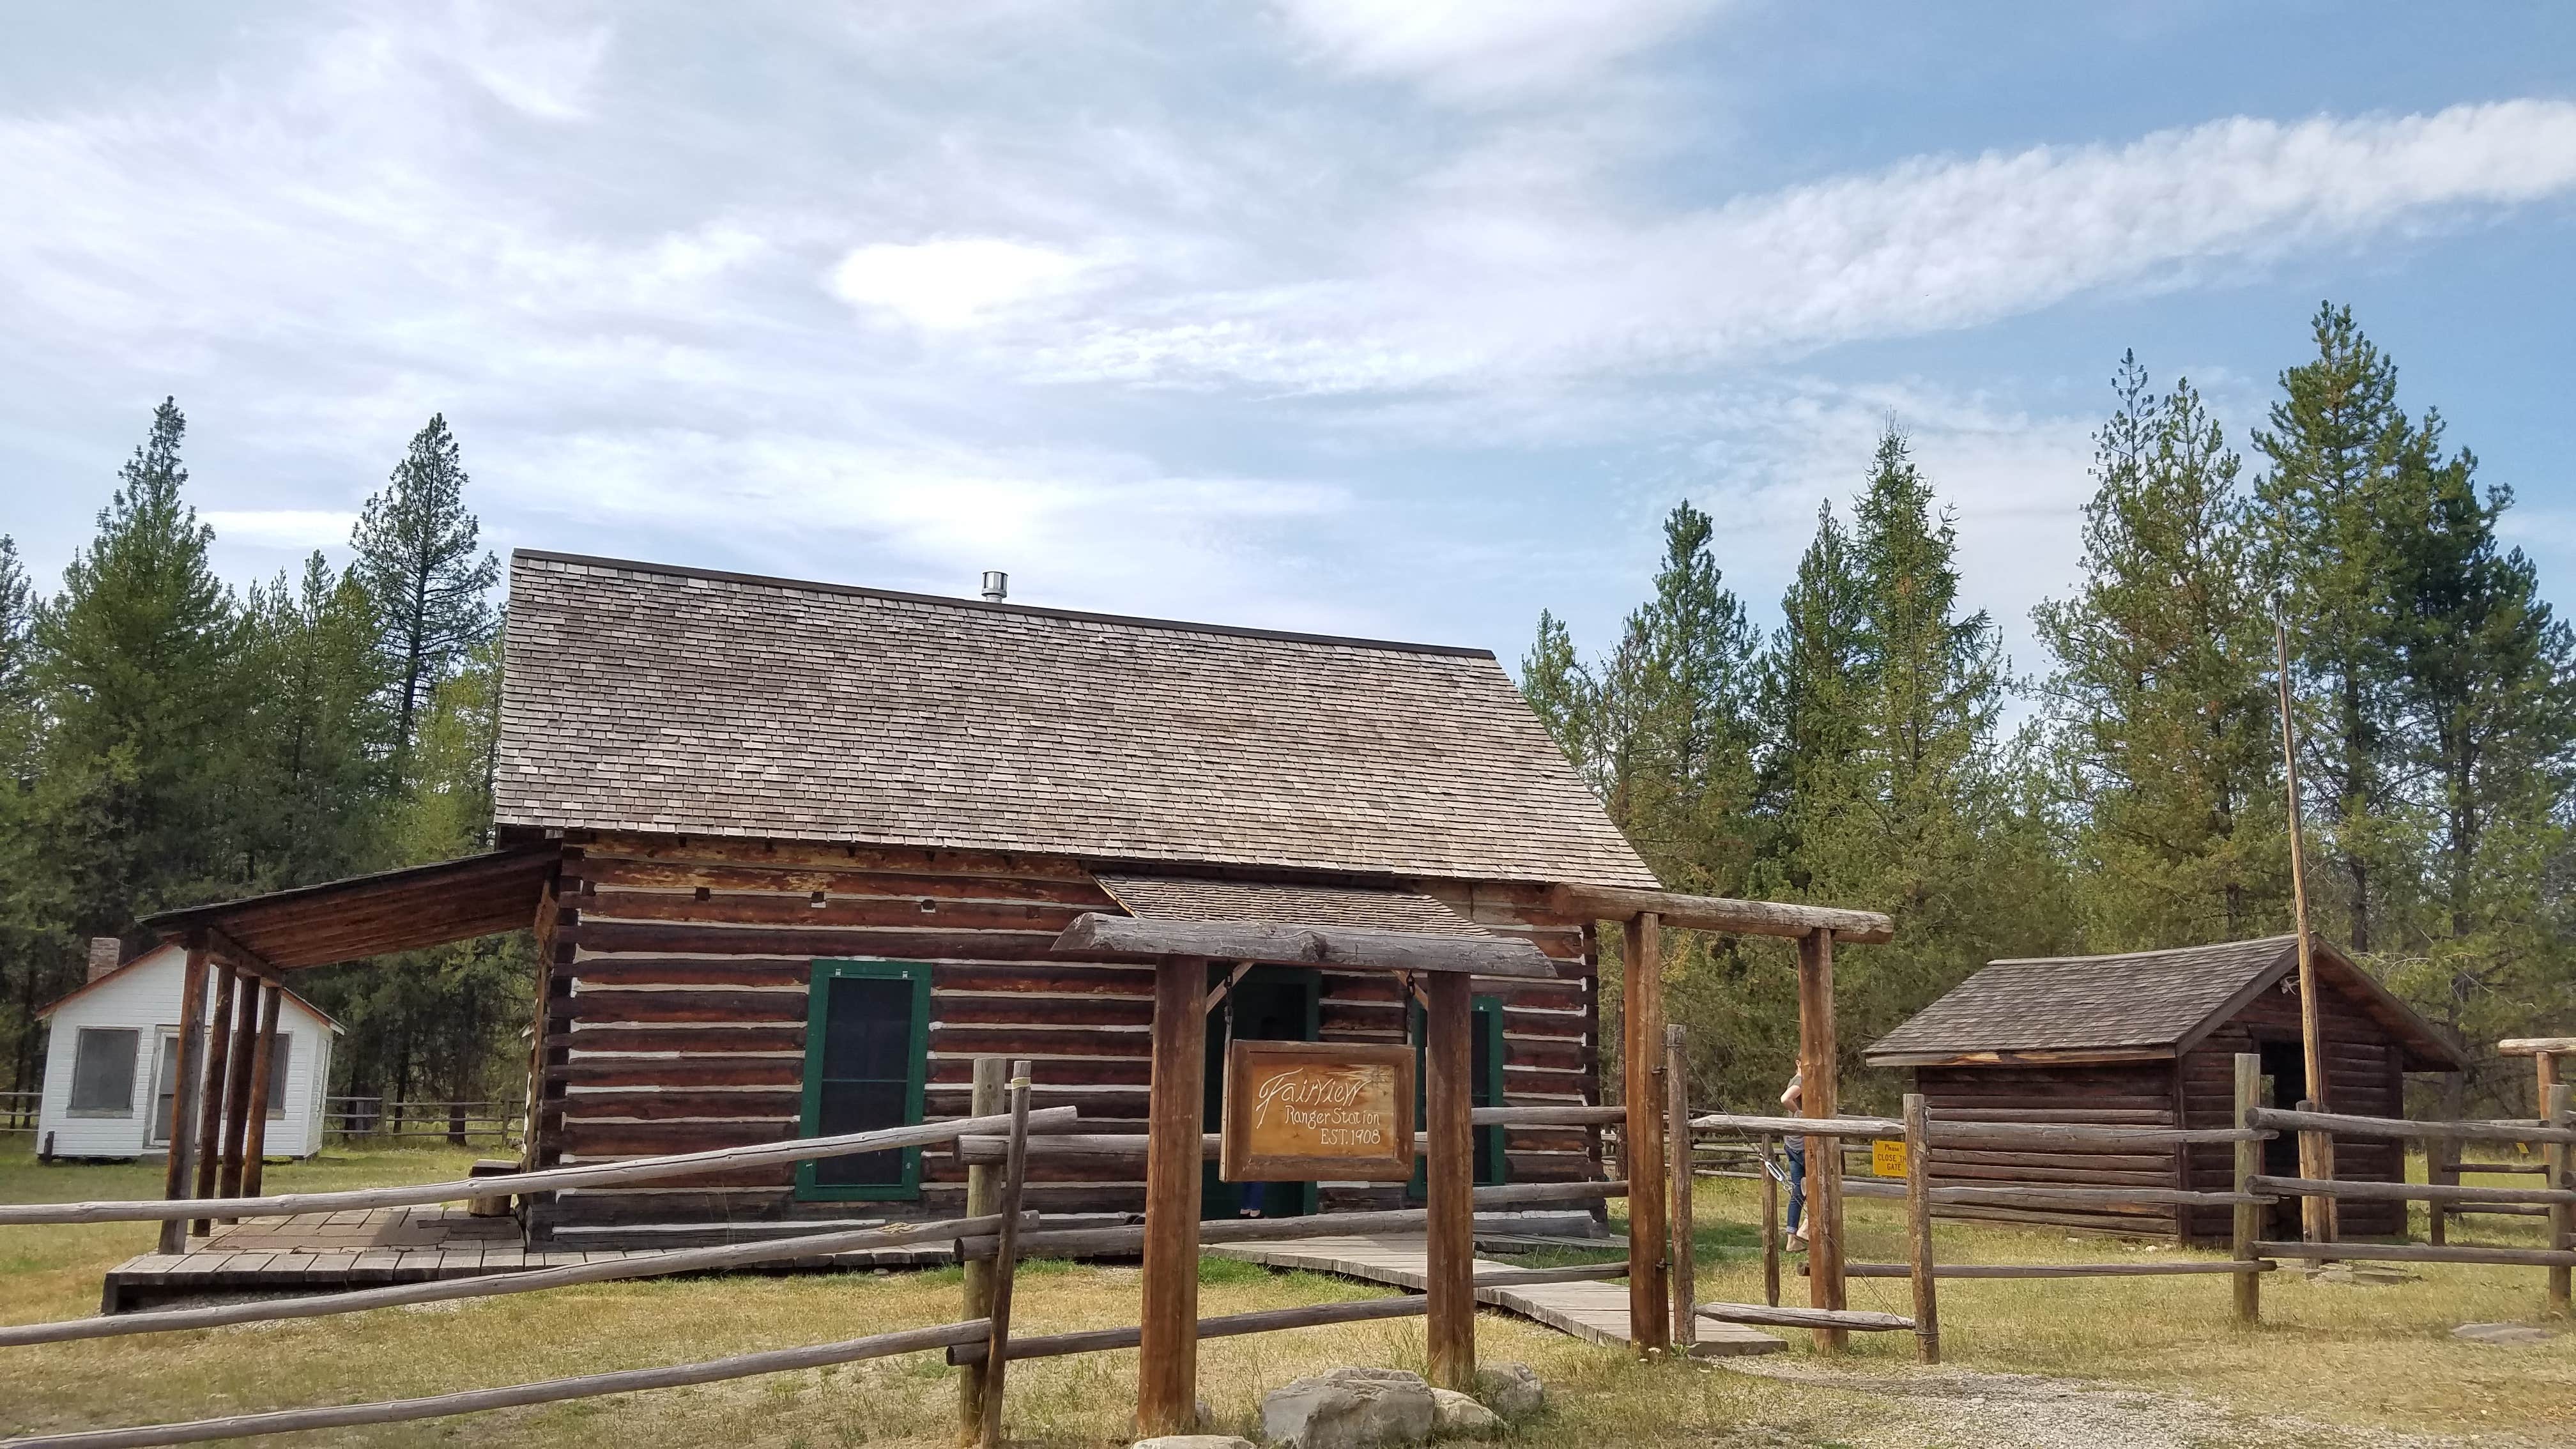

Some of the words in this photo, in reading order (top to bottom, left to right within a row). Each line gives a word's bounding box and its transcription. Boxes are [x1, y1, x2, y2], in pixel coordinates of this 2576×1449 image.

[1285, 1105, 1331, 1130] Ranger
[1331, 1107, 1380, 1126] Station
[1351, 1128, 1381, 1145] 1908
